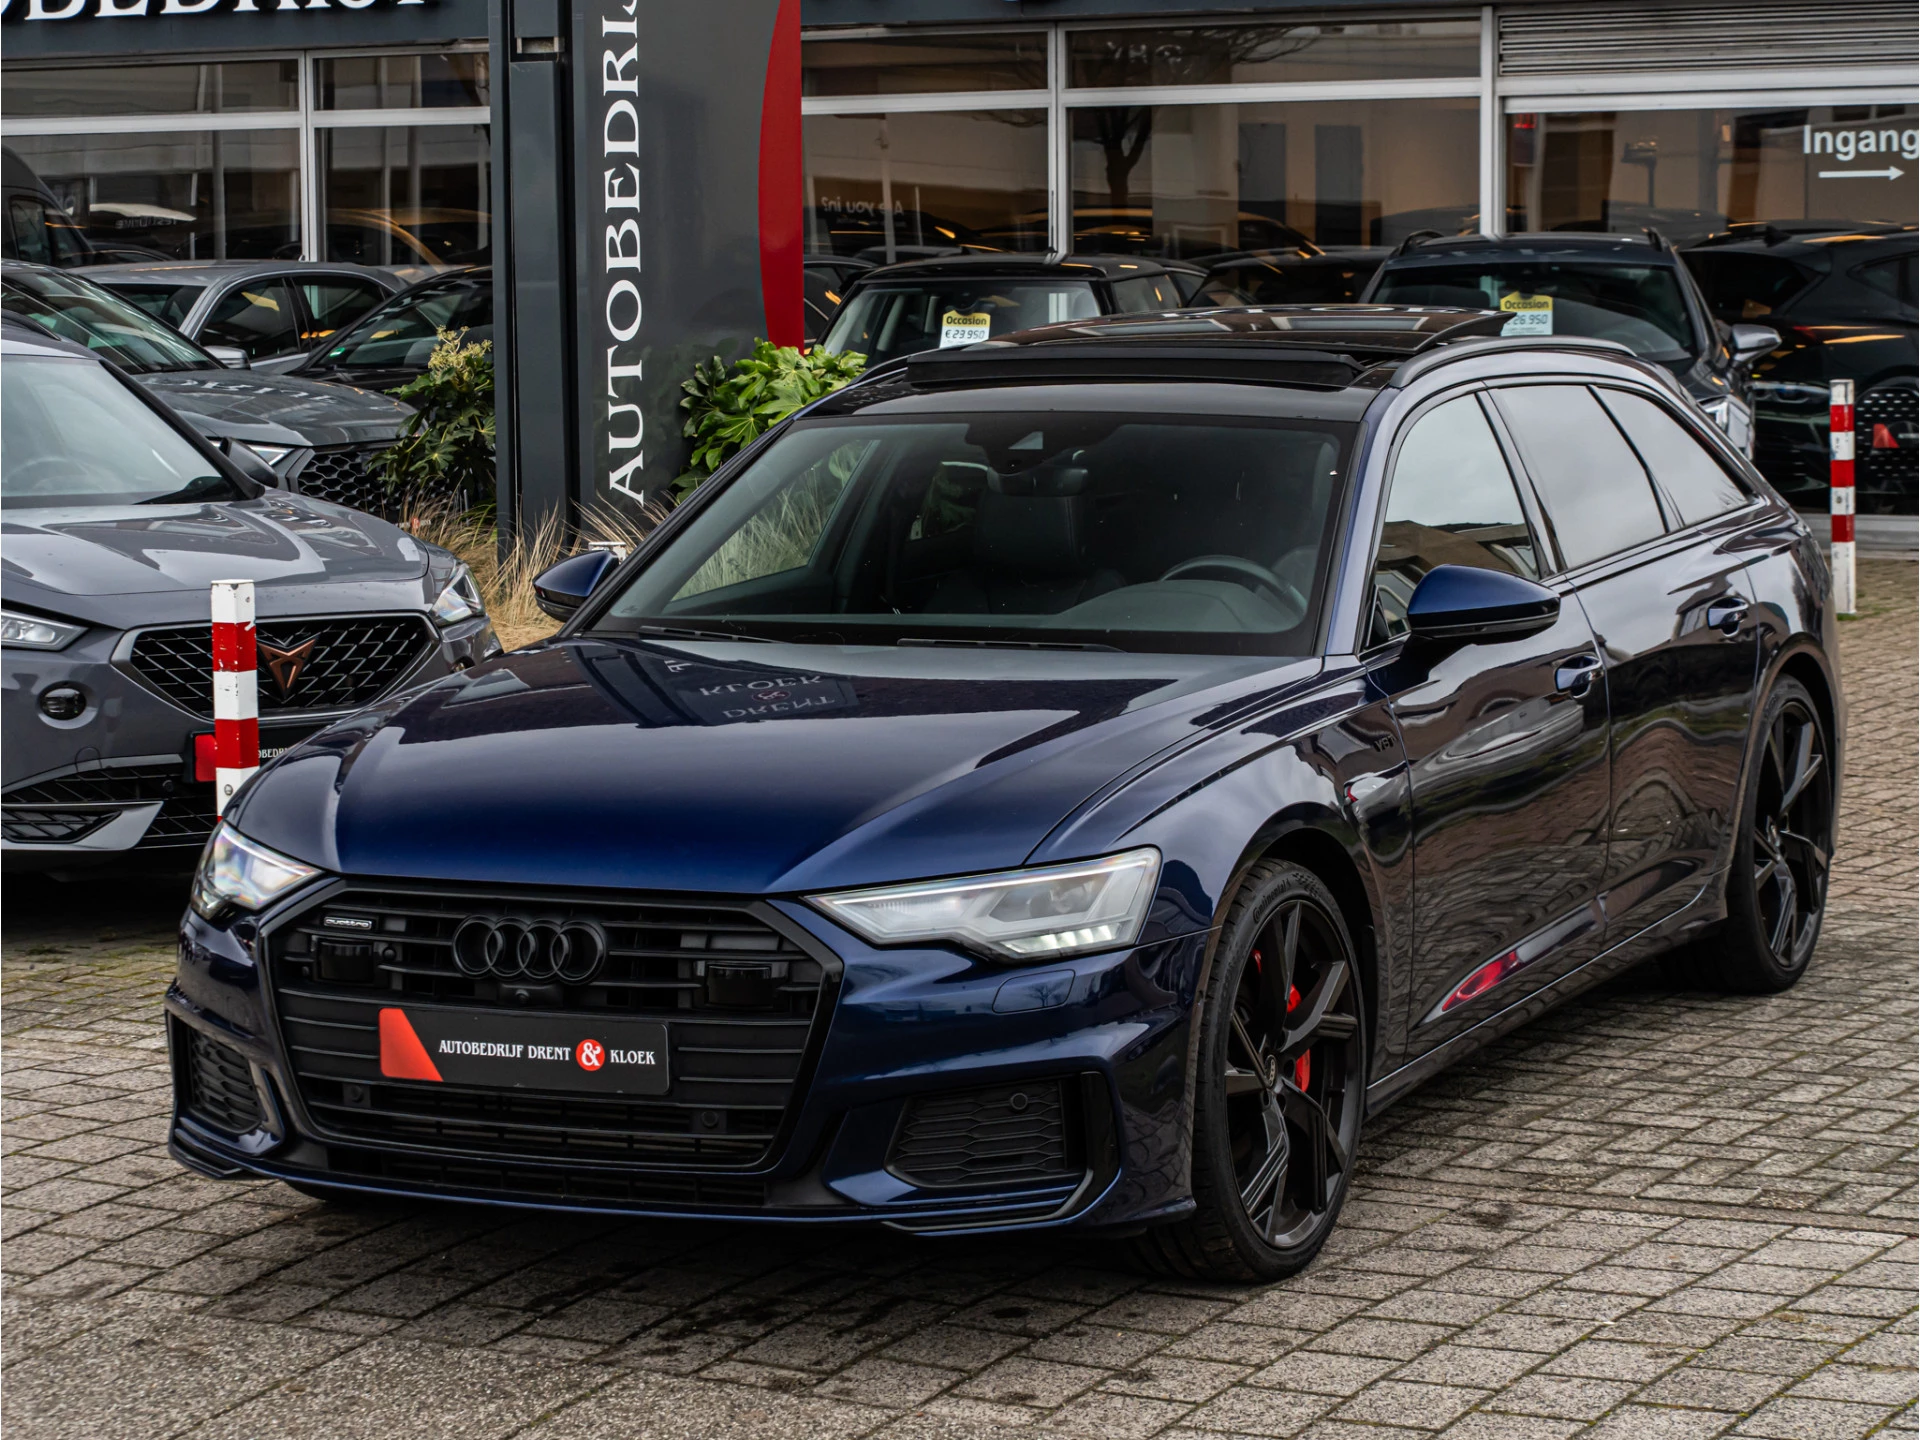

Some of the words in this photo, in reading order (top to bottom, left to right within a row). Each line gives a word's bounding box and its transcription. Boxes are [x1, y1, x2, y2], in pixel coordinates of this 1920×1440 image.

[1803, 125, 1919, 161] Ingang
[1504, 299, 1549, 309] Occasion
[946, 316, 987, 325] Occasion
[1252, 879, 1287, 924] Continental
[325, 919, 370, 928] quattro
[439, 1039, 524, 1058] AUTOBEDRIJF
[528, 1045, 571, 1061] DRENT
[581, 1042, 601, 1066] &
[610, 1049, 656, 1065] KLOEK
